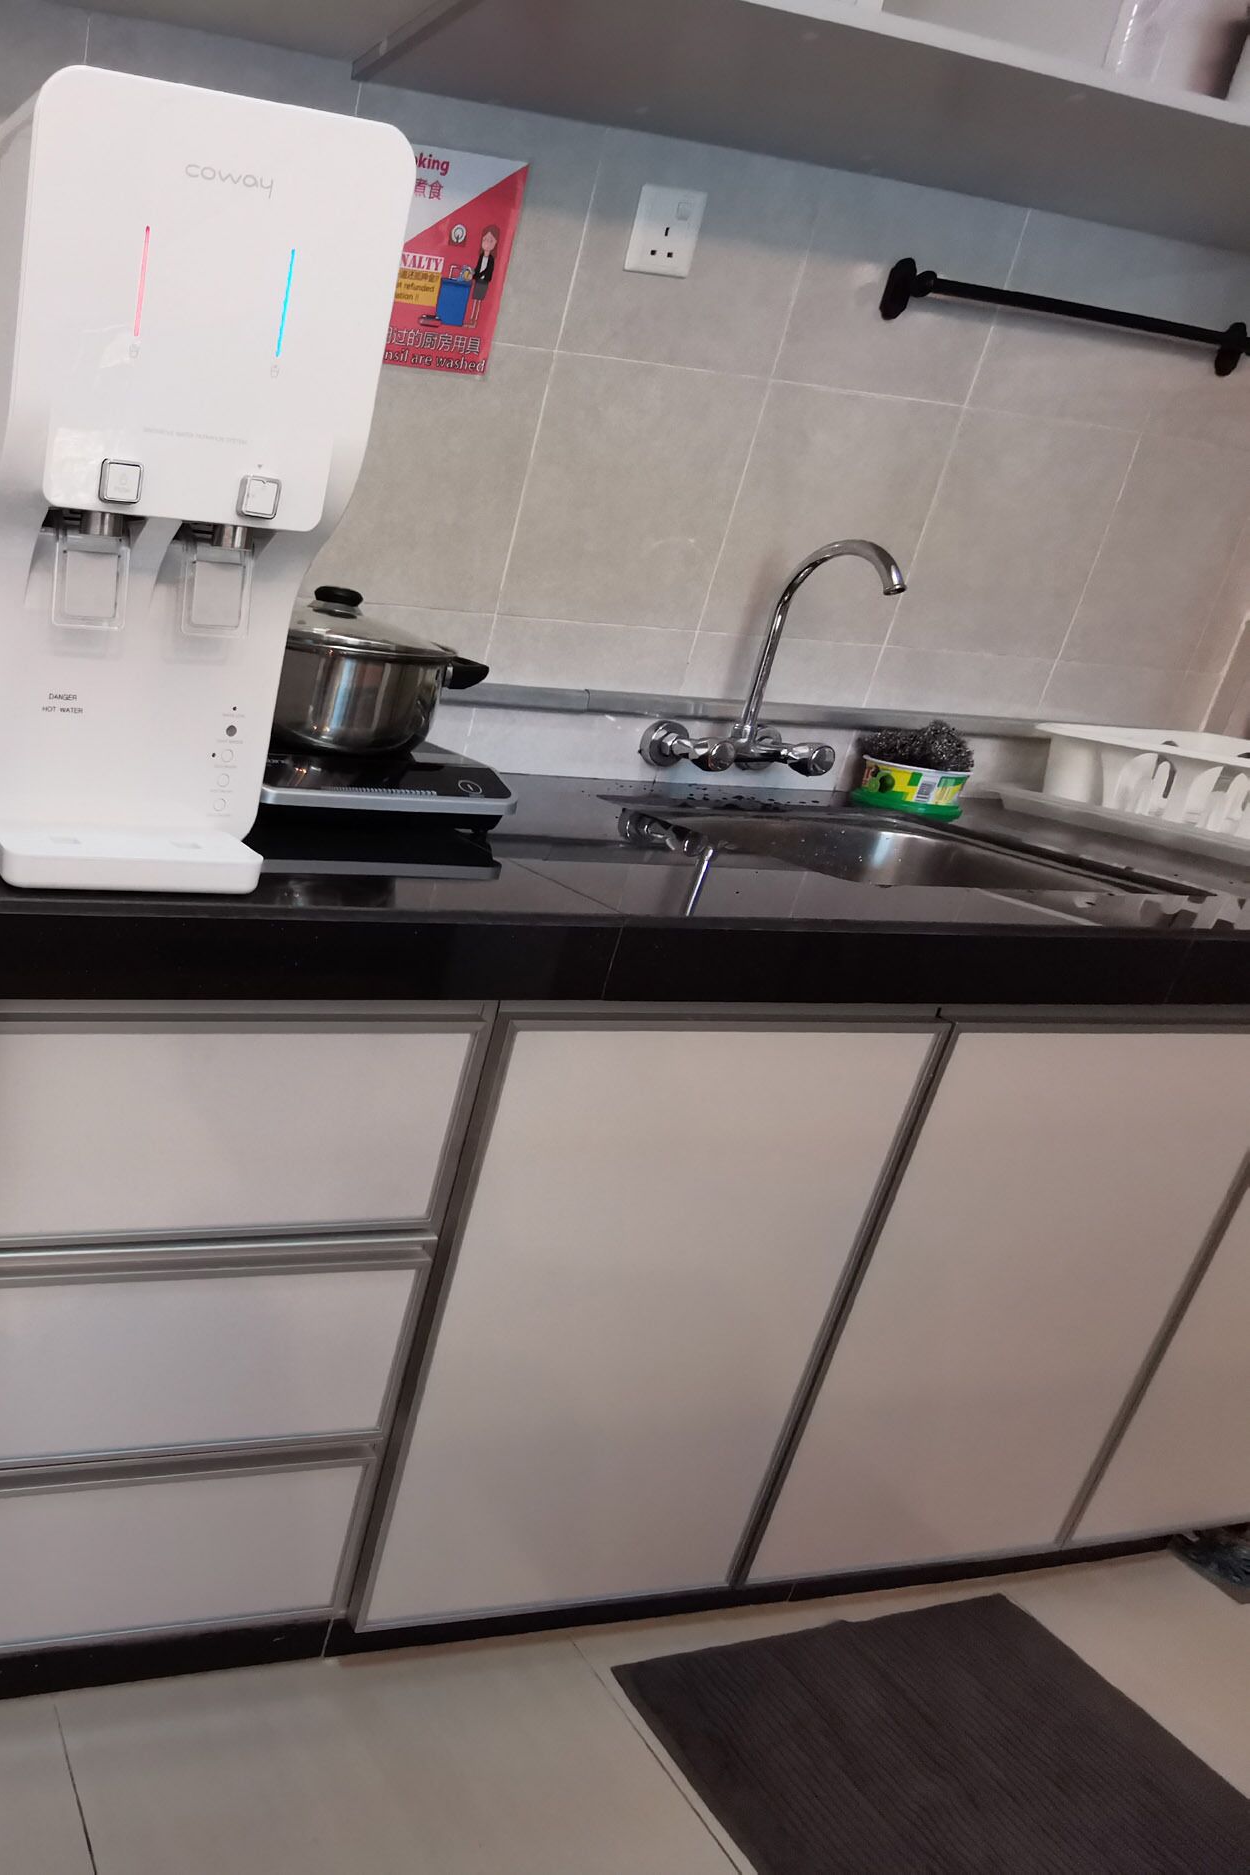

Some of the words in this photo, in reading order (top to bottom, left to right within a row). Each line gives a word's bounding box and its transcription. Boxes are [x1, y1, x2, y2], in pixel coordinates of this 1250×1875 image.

[415, 152, 450, 176] king
[185, 163, 274, 199] coway
[411, 353, 433, 366] are
[436, 356, 486, 373] washed
[48, 693, 77, 701] DANGER
